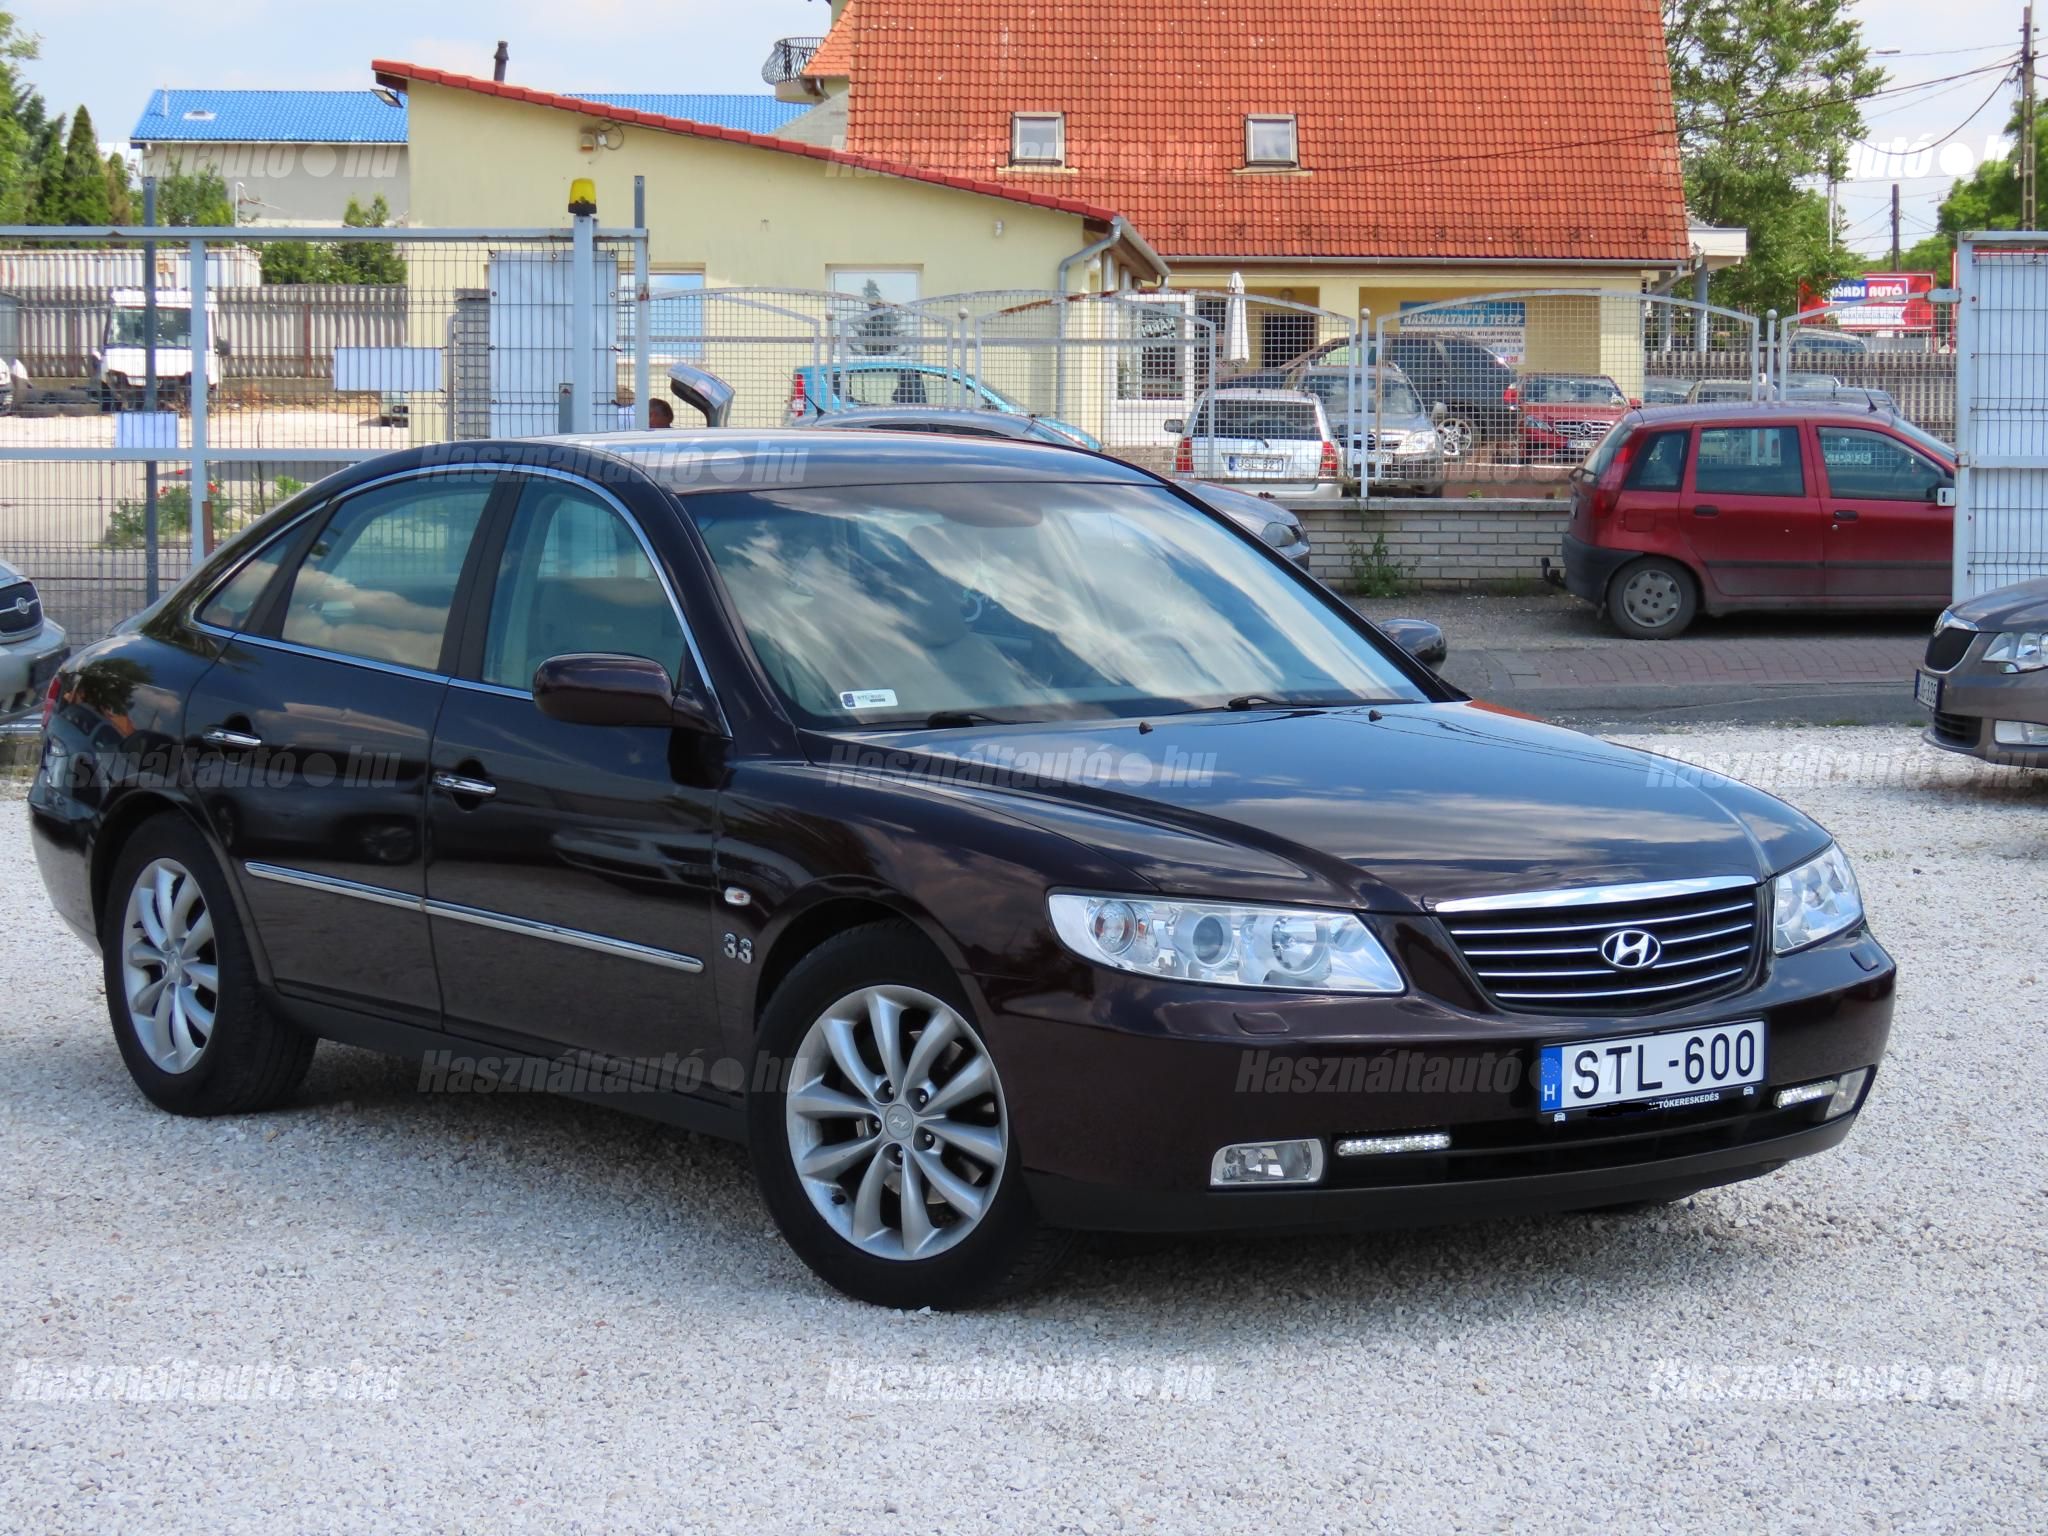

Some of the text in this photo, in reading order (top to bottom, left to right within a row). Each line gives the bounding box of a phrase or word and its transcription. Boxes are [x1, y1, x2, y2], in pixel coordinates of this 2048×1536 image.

[1868, 282, 1904, 297] AUTÓ
[1489, 313, 1522, 324] TELEP
[1573, 1028, 1756, 1100] STL-600
[1544, 1084, 1556, 1102] H
